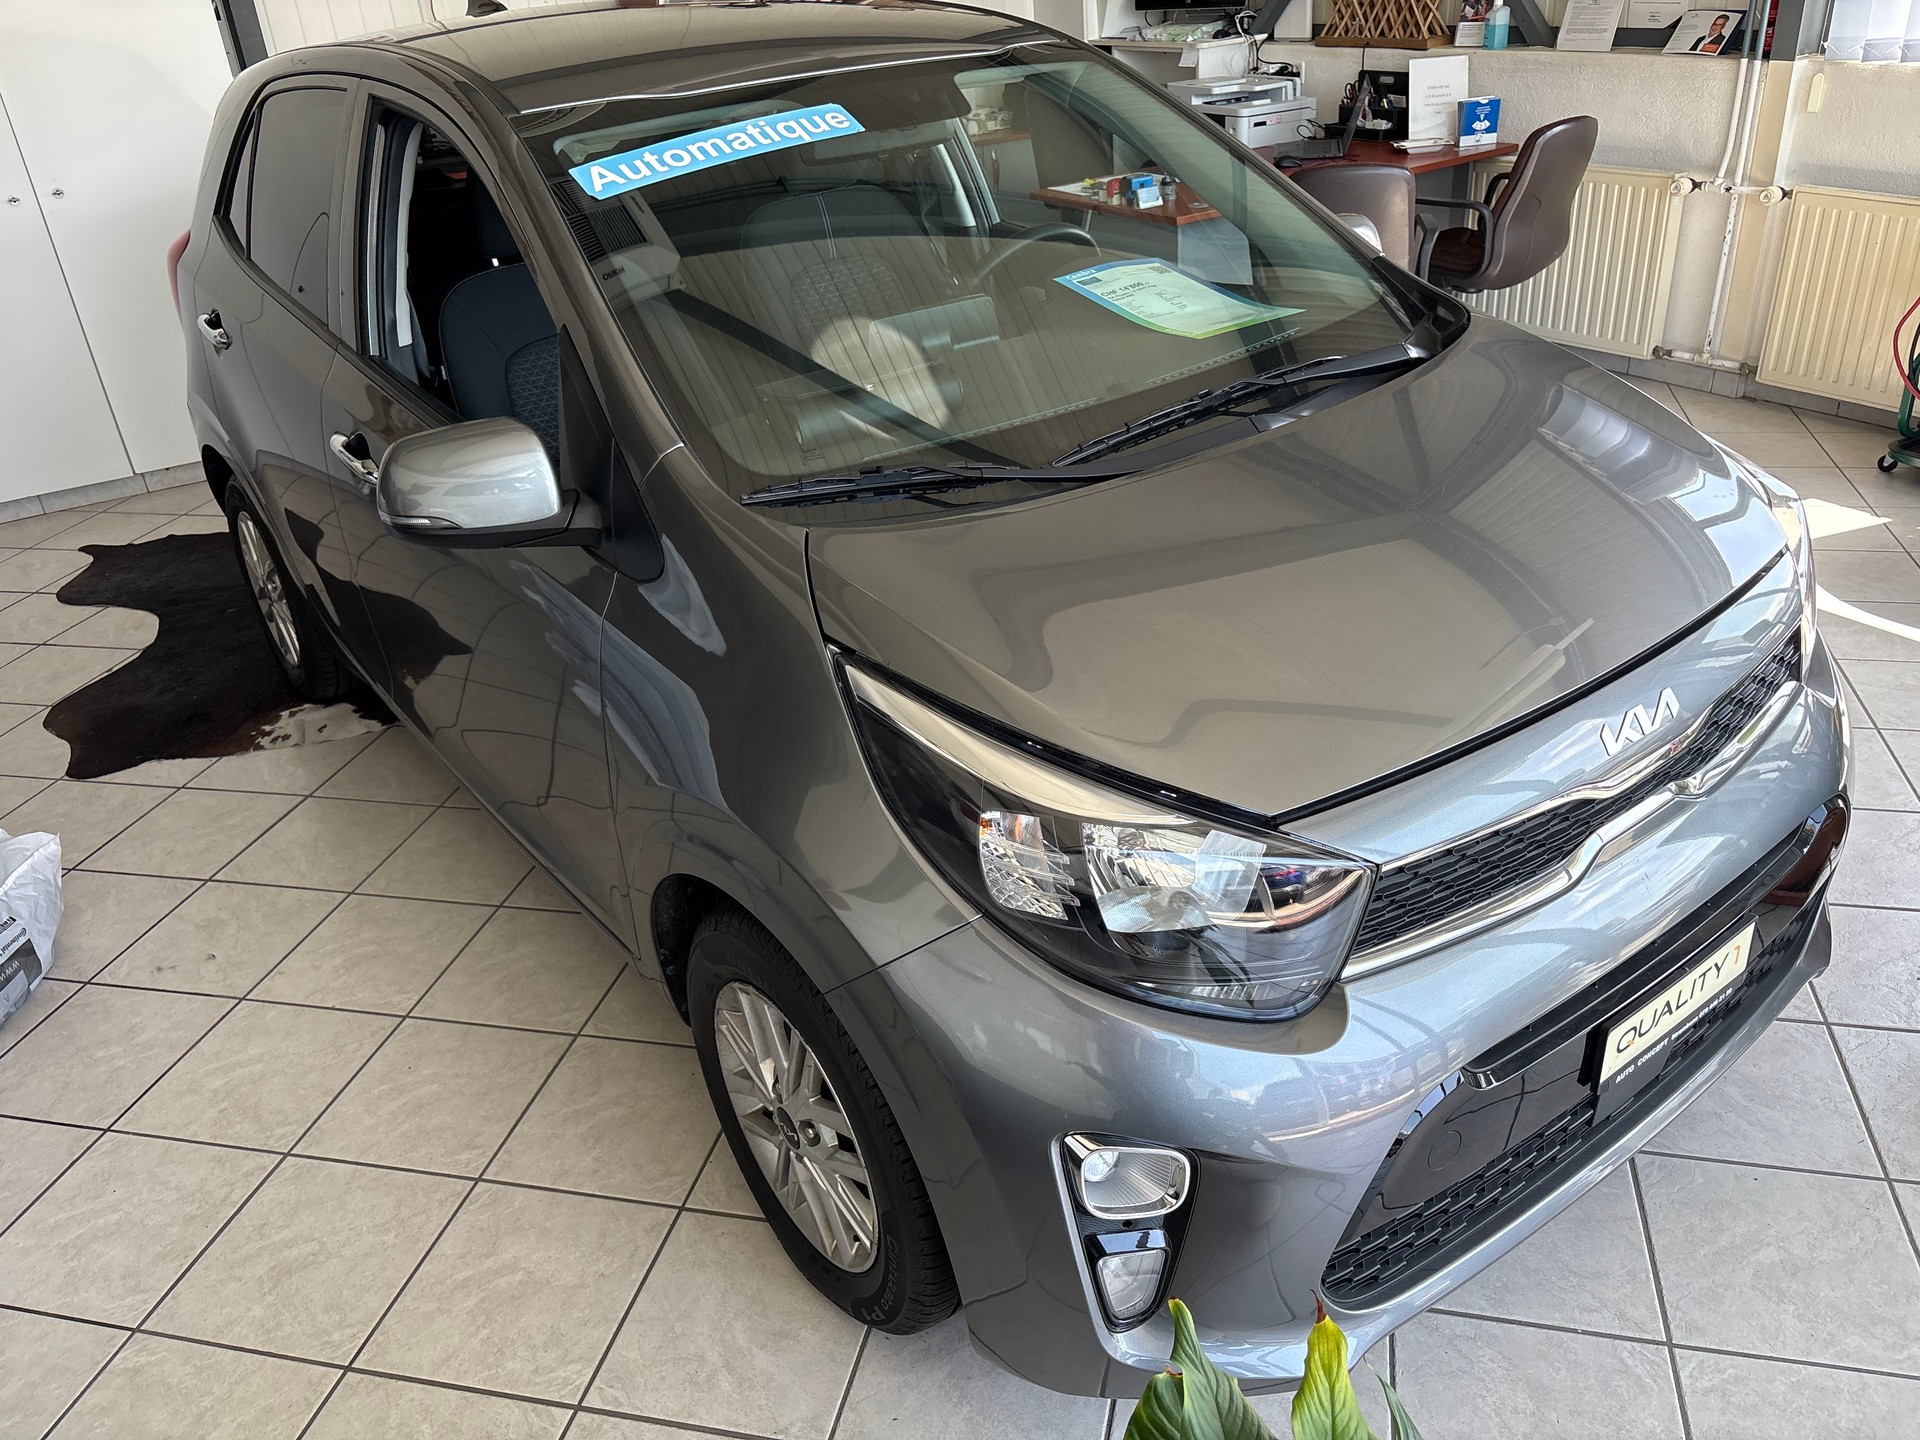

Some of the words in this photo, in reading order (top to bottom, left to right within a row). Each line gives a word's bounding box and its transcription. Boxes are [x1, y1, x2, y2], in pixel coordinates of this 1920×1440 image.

[589, 112, 850, 191] Automatique
[1101, 289, 1117, 297] CHF
[1600, 686, 1680, 756] KIA
[2, 927, 27, 955] Continental
[1616, 951, 1730, 1054] QUALITY
[1615, 1064, 1635, 1084] AUTO
[1637, 1037, 1669, 1067] CONCEPT
